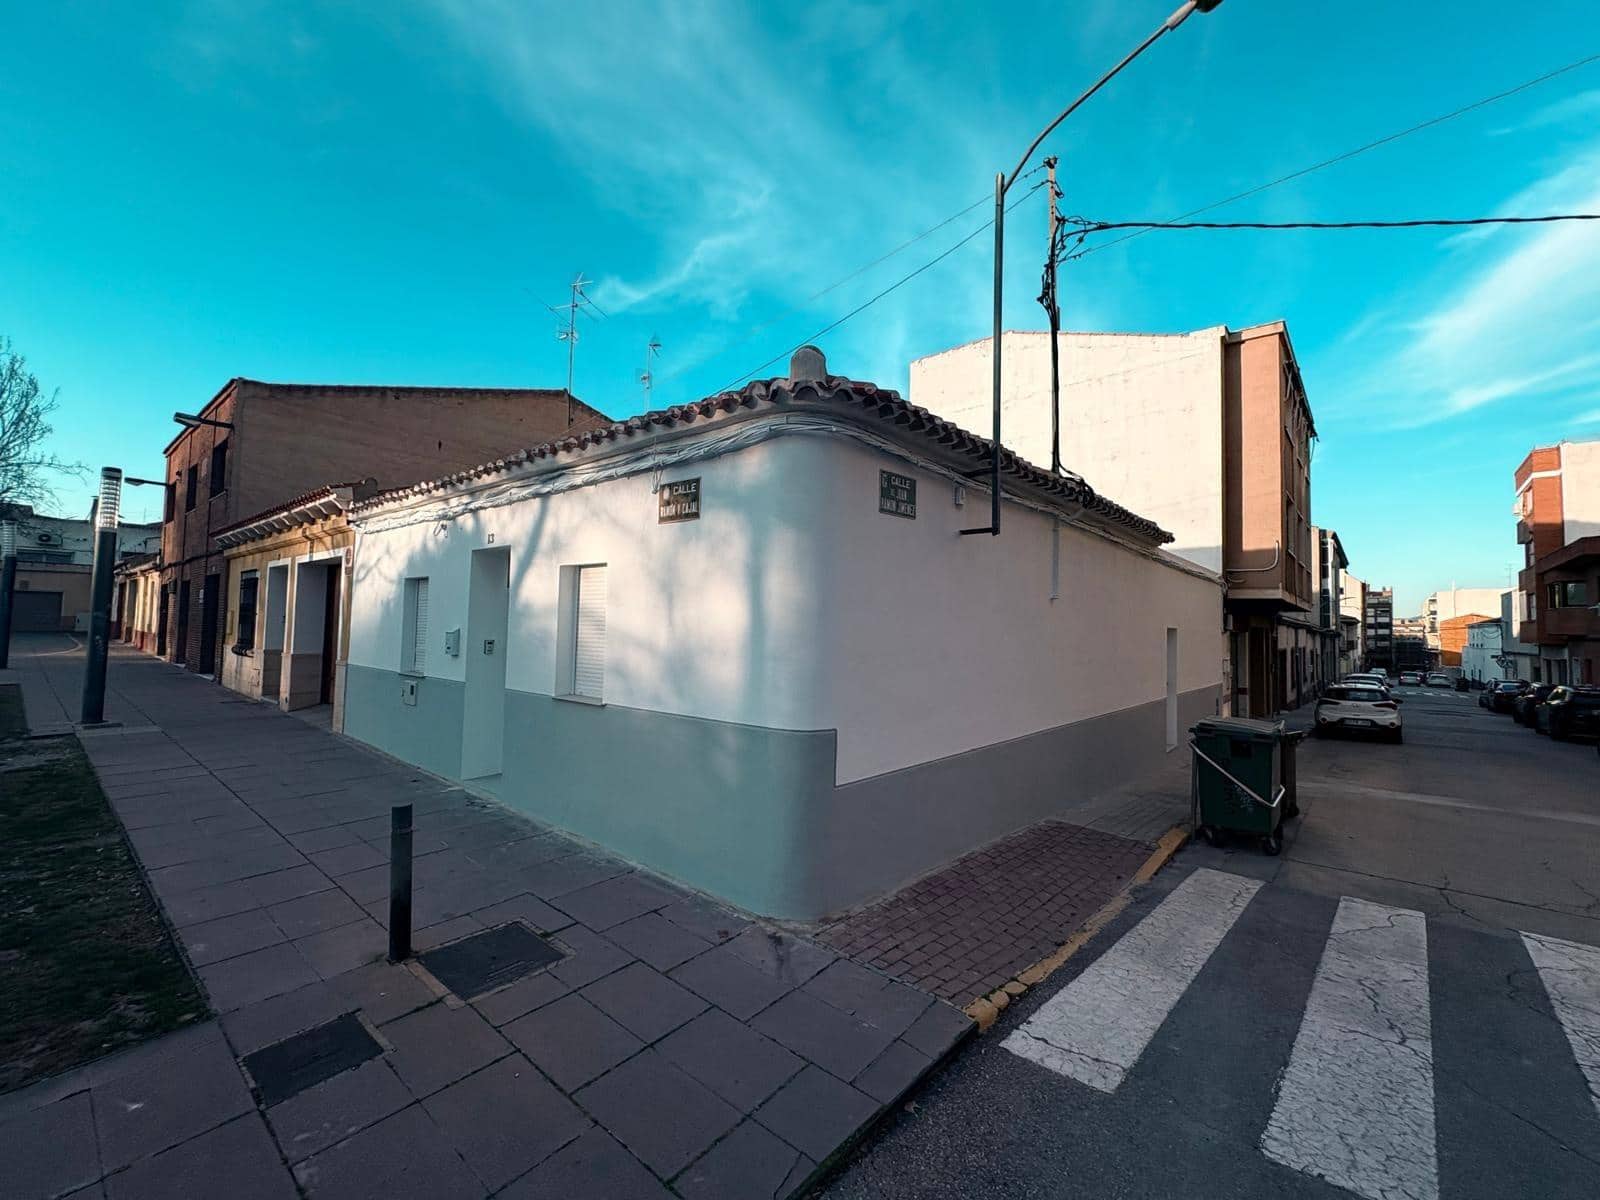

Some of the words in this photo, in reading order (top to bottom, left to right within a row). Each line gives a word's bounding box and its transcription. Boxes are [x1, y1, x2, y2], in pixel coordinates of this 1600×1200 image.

[891, 476, 911, 489] CALLE
[673, 483, 697, 495] CALLE
[487, 533, 495, 544] 13
